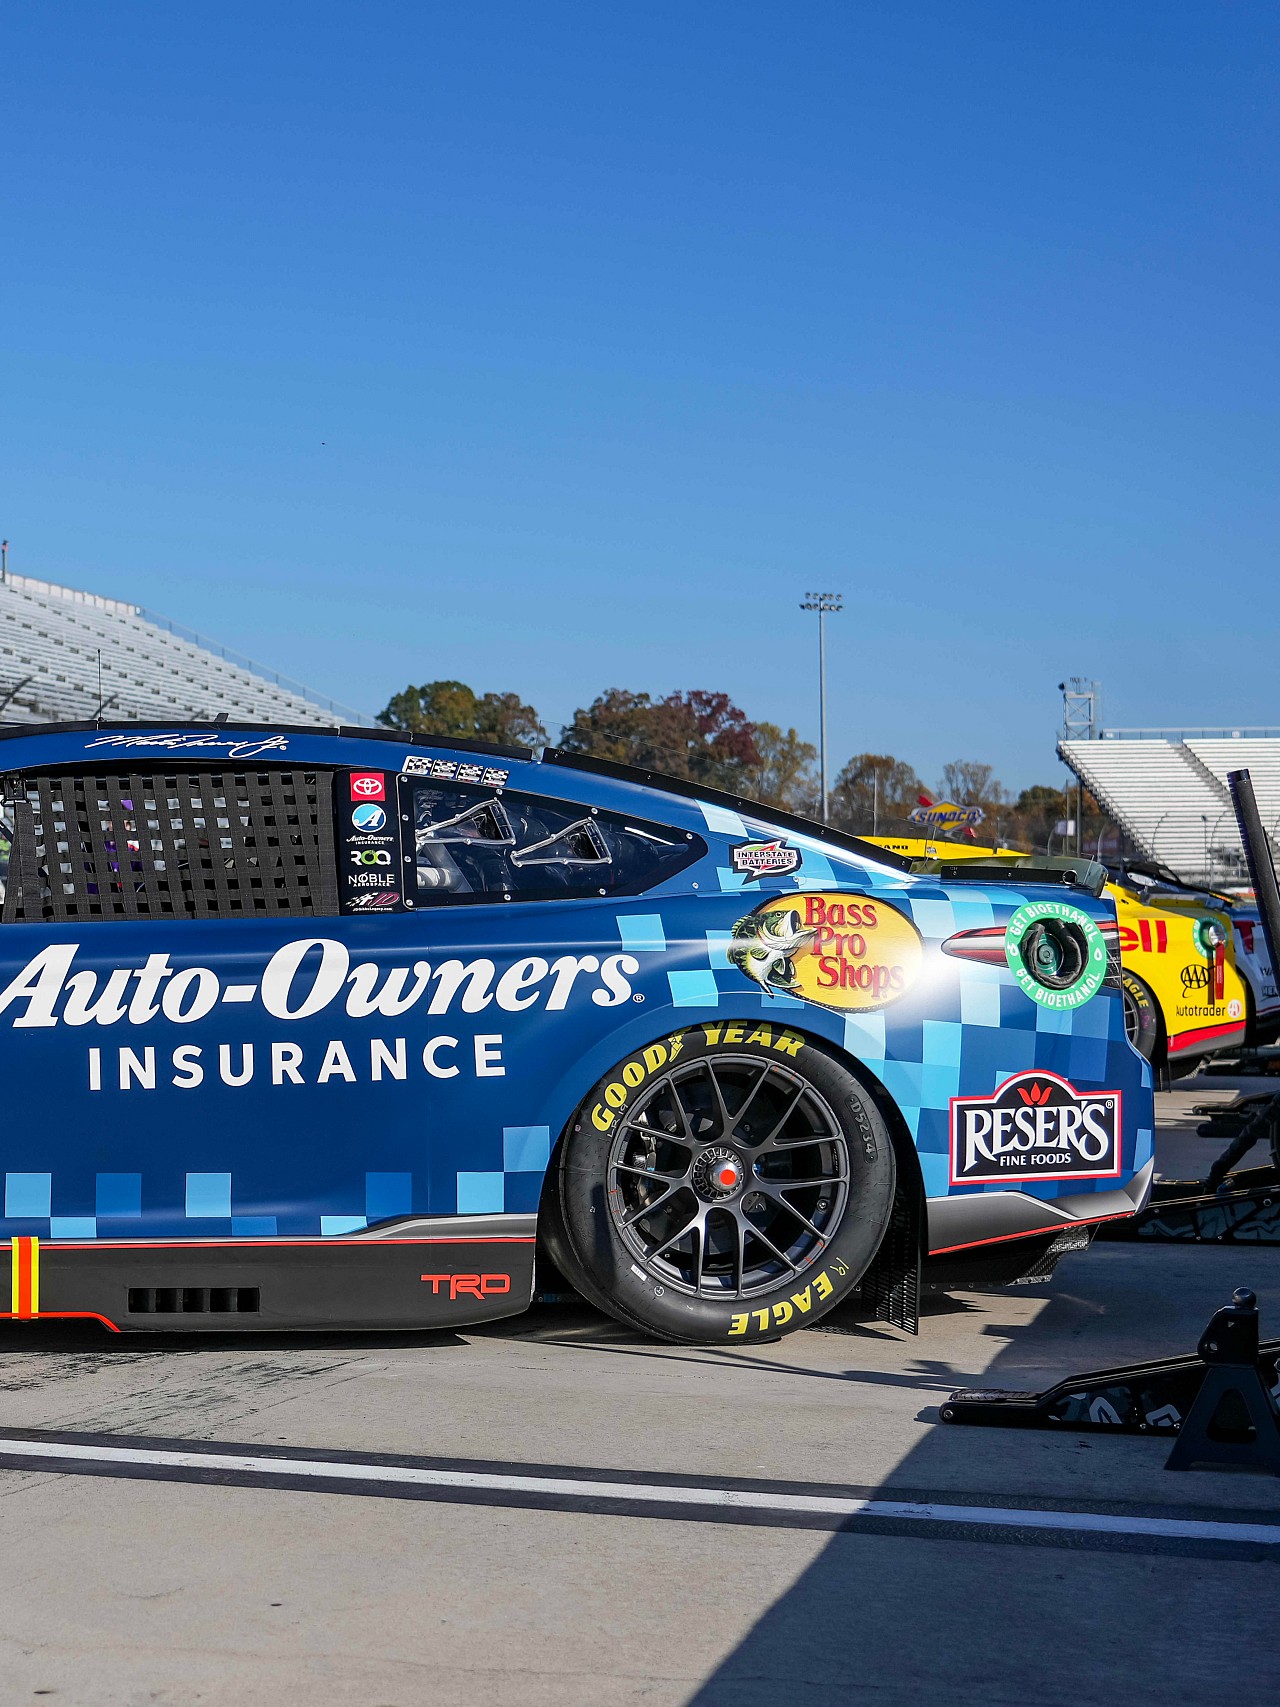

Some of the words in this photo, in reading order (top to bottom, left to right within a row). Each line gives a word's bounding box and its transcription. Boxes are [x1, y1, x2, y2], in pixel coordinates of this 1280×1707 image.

[919, 811, 977, 823] SUNOCO
[350, 849, 391, 866] ROQ
[742, 858, 793, 866] BATTERIES
[803, 896, 878, 928] Bass
[1009, 913, 1028, 936] GET
[1025, 903, 1099, 943] BIOETHANOL
[809, 926, 867, 956] Pro
[817, 956, 905, 998] Shops
[1016, 968, 1037, 991] GET
[1035, 973, 1100, 1007] BIOETHANOL
[1122, 973, 1149, 1008] AGLE
[1176, 1004, 1226, 1017] Autotrader
[88, 1034, 507, 1092] INSURANCE
[850, 1100, 876, 1154] D5234
[962, 1100, 1109, 1173] RESER'S
[1000, 1154, 1027, 1167] FINE
[1030, 1153, 1071, 1166] FOODS
[420, 1273, 511, 1300] TRD
[727, 1271, 834, 1336] EAGLE
